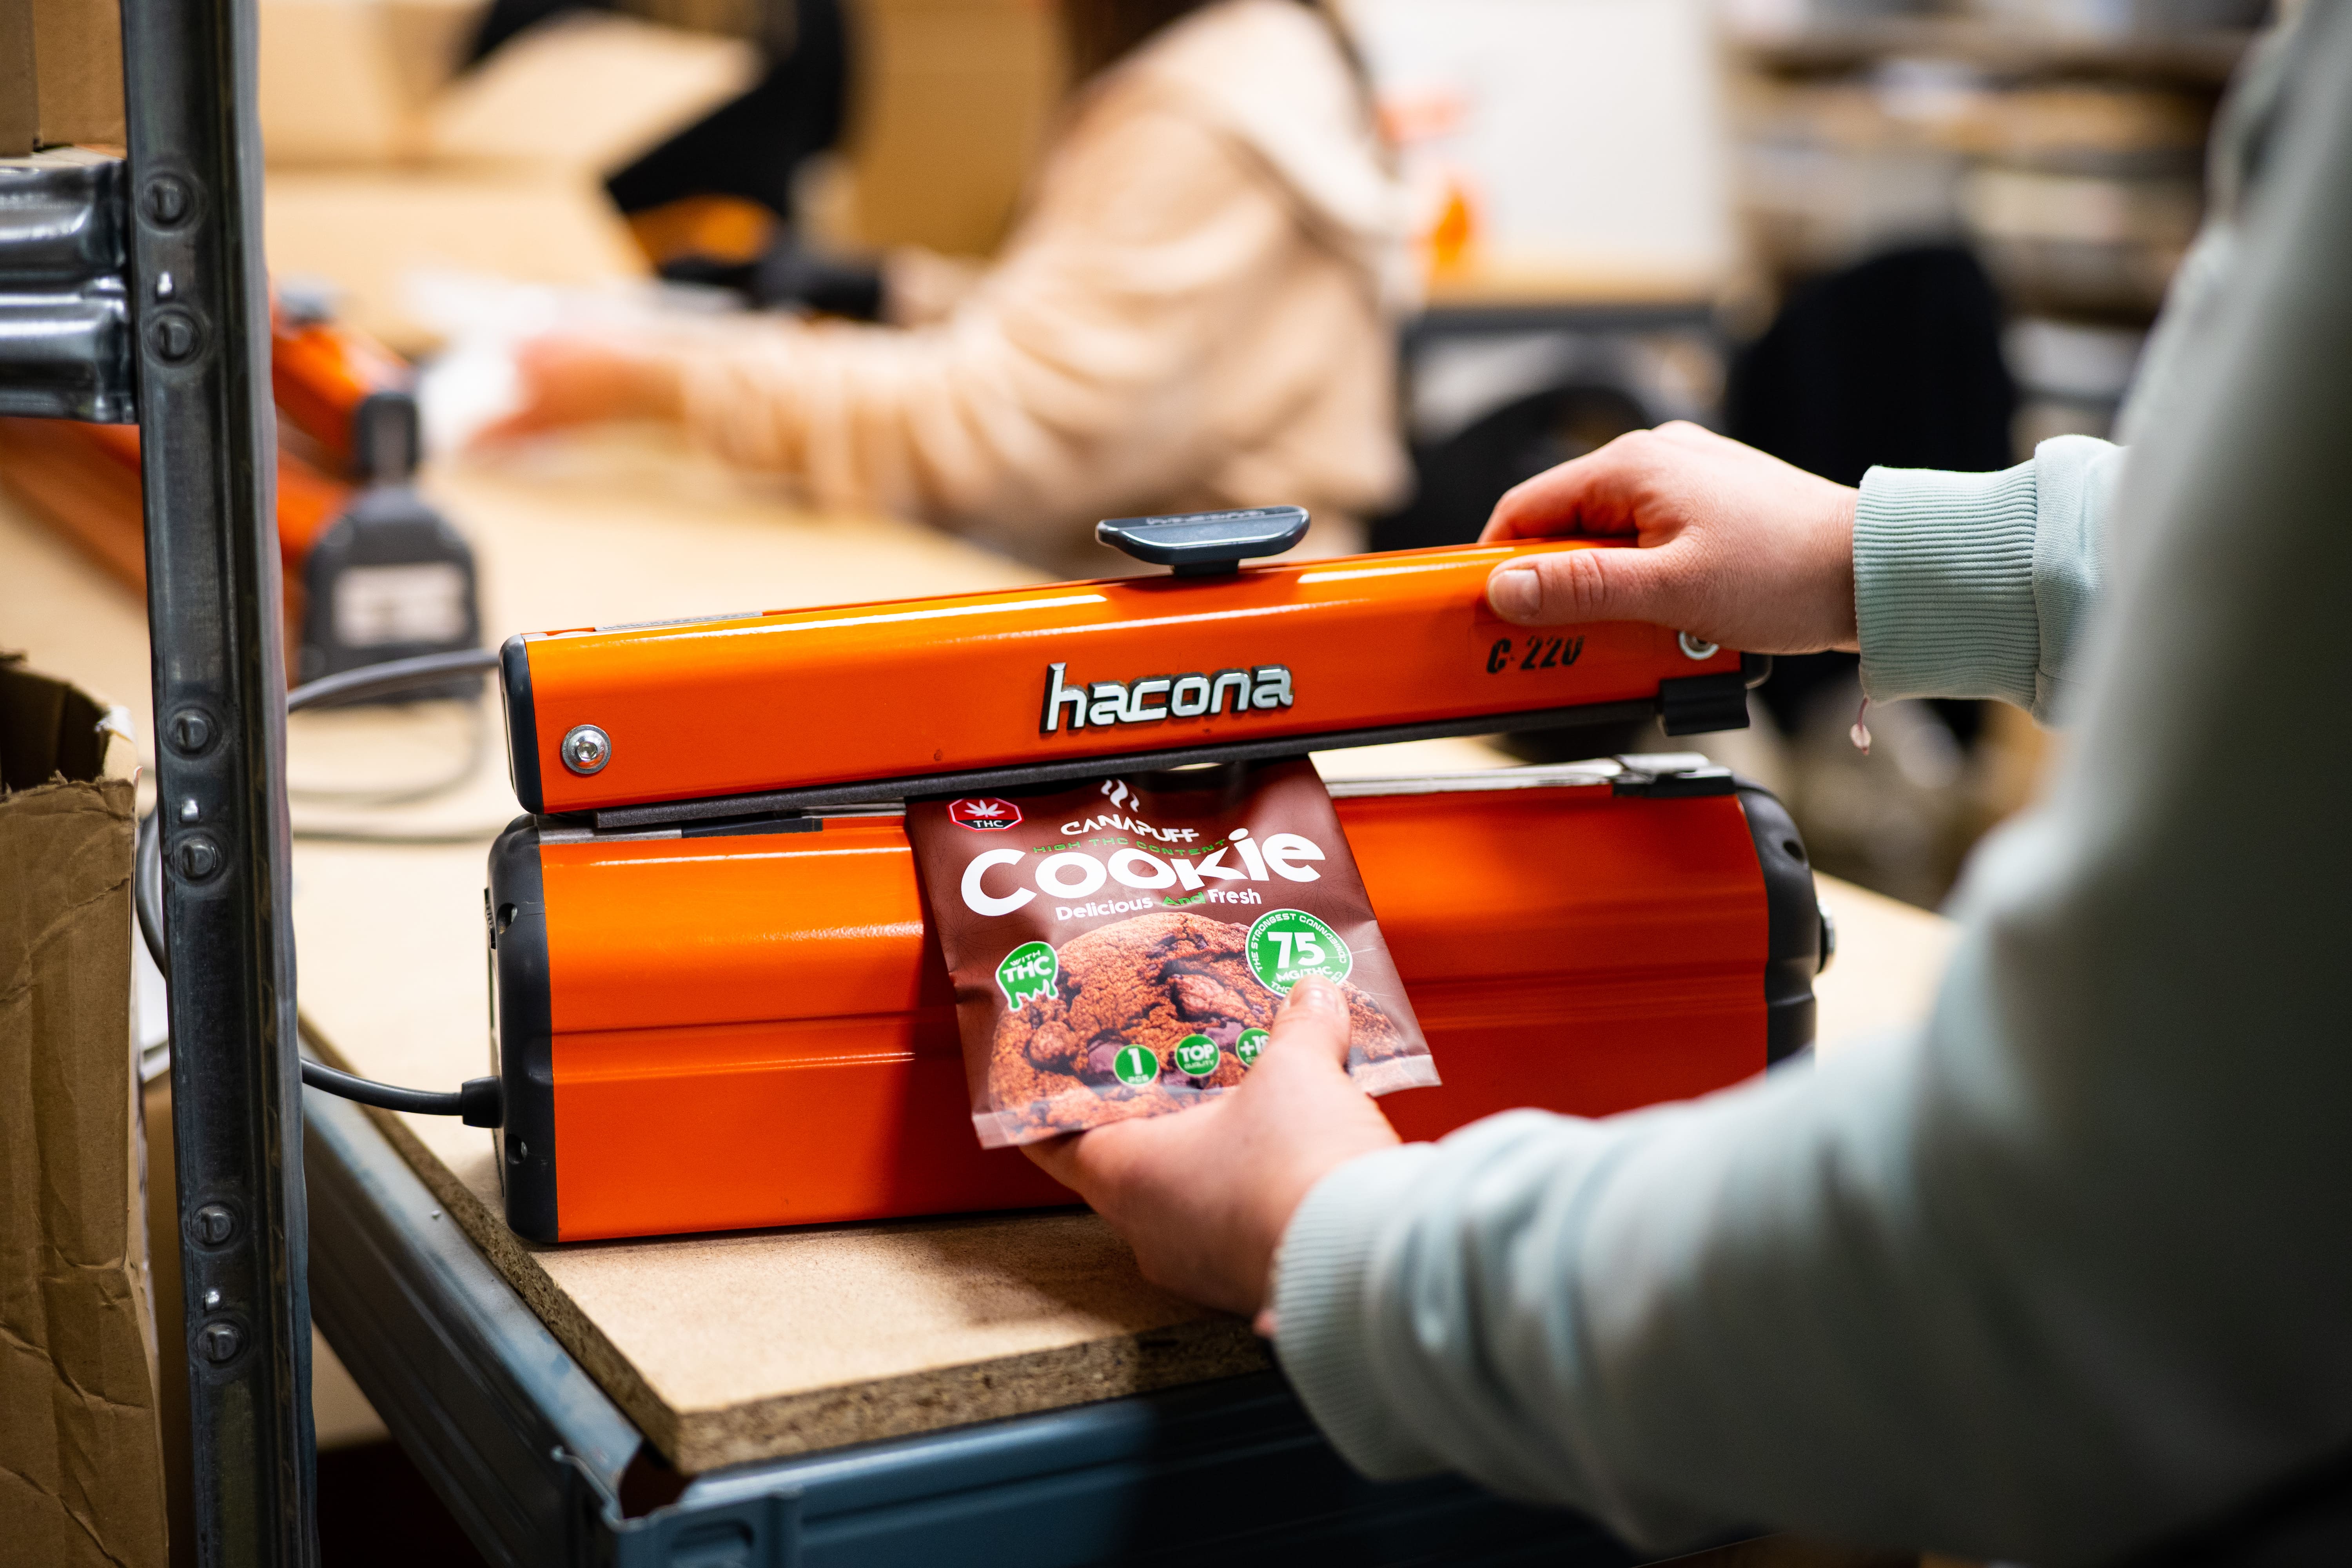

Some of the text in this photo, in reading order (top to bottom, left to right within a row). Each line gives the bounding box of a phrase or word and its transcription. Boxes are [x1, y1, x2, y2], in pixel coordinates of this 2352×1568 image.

[1040, 662, 1294, 733] hacona
[1061, 813, 1200, 843] CANAPUFF
[1033, 837, 1225, 856] HIGH THC CONTENT
[1055, 888, 1262, 921] Delicious And Fresh
[1250, 913, 1297, 950] STRONGEST
[1009, 949, 1041, 966] WITH
[1251, 951, 1263, 973] THE
[1267, 931, 1326, 969] 75
[1002, 956, 1053, 983] THC
[1128, 1047, 1143, 1074] 1
[1179, 1044, 1214, 1063] TOP
[1184, 1060, 1215, 1069] QUALITY
[1127, 1075, 1149, 1083] PCS
